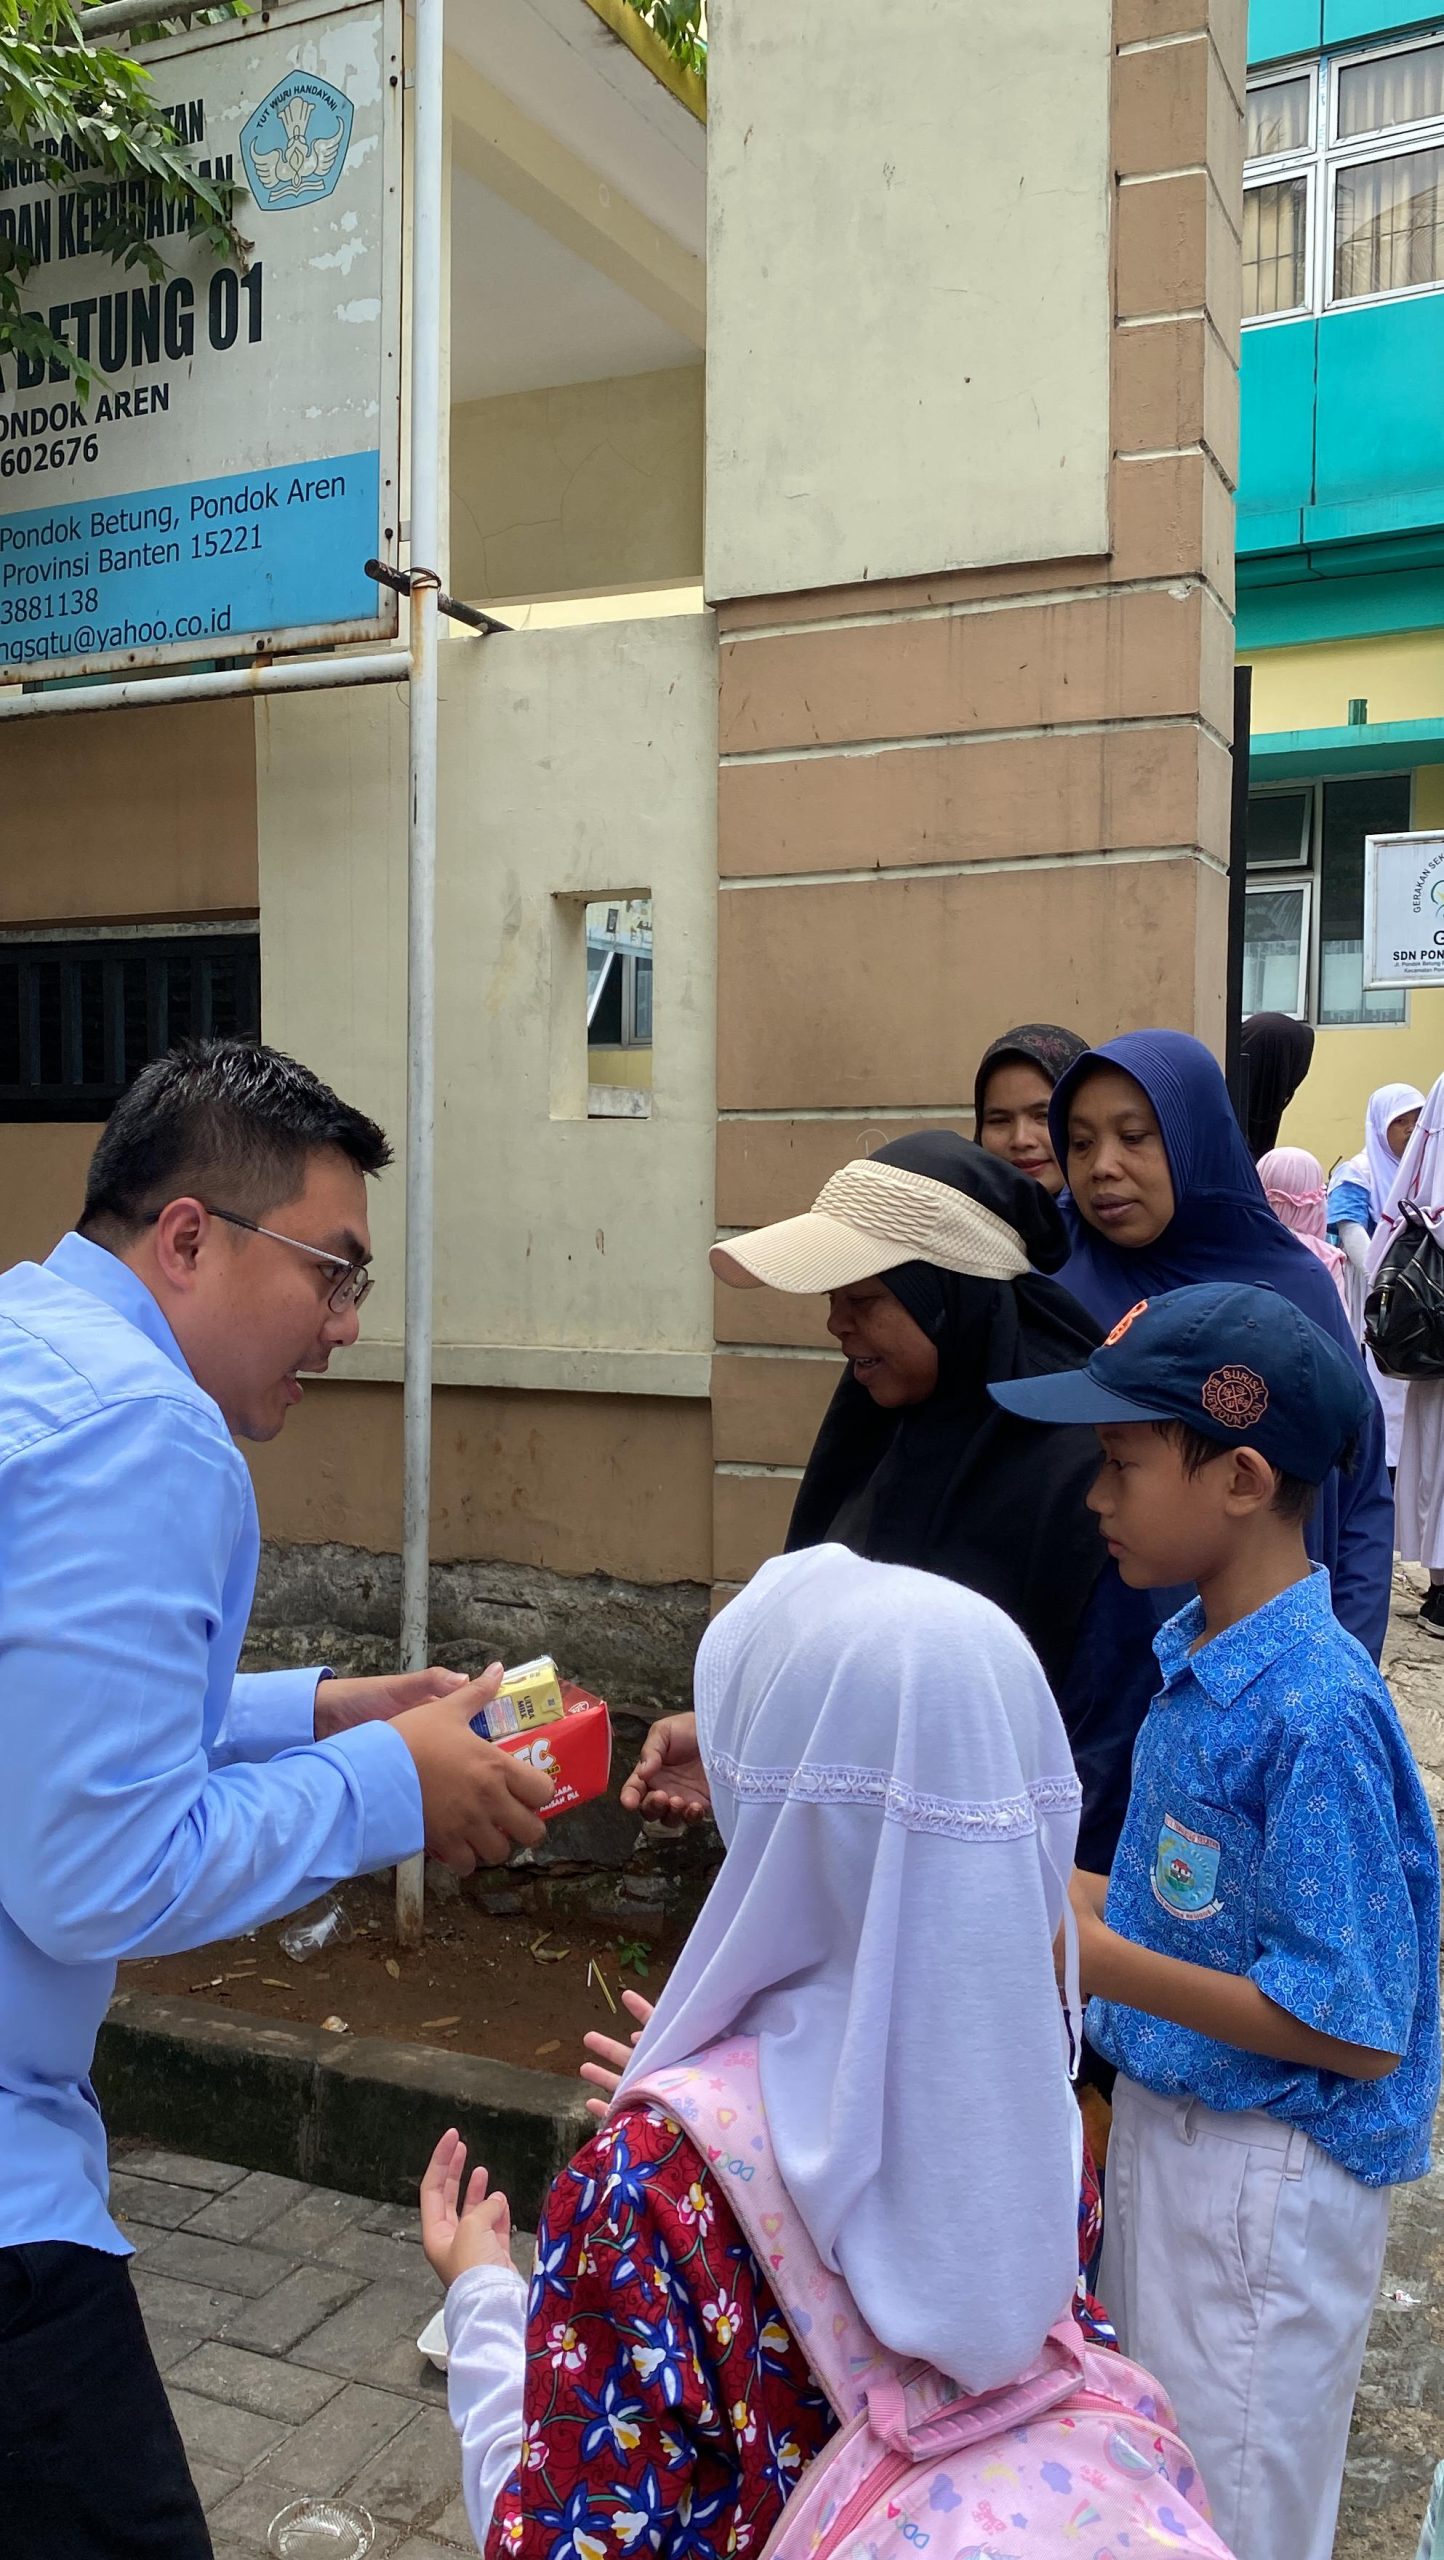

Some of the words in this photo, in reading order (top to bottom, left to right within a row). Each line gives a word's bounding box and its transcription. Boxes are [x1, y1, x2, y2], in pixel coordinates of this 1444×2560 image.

[256, 108, 271, 129] TUT
[269, 89, 292, 110] WURI
[293, 84, 338, 111] HANDAYANI
[0, 198, 51, 268] DAN
[17, 276, 195, 390] BETUNG
[208, 261, 263, 351] 01
[95, 382, 169, 424] AREN
[1, 433, 98, 477] 602676
[0, 516, 82, 552] Pondok
[90, 505, 180, 538] Betung,
[190, 482, 280, 521] Pondok
[286, 475, 345, 506] Aren
[3, 552, 89, 588] Provinsi
[100, 541, 180, 574] Banten
[191, 524, 262, 560] 15221
[0, 587, 98, 625] 3881138
[1413, 868, 1431, 913] GERAKAN
[1393, 950, 1416, 961] SDN
[517, 1700, 528, 1720] MILK
[523, 1695, 535, 1720] ULTRA
